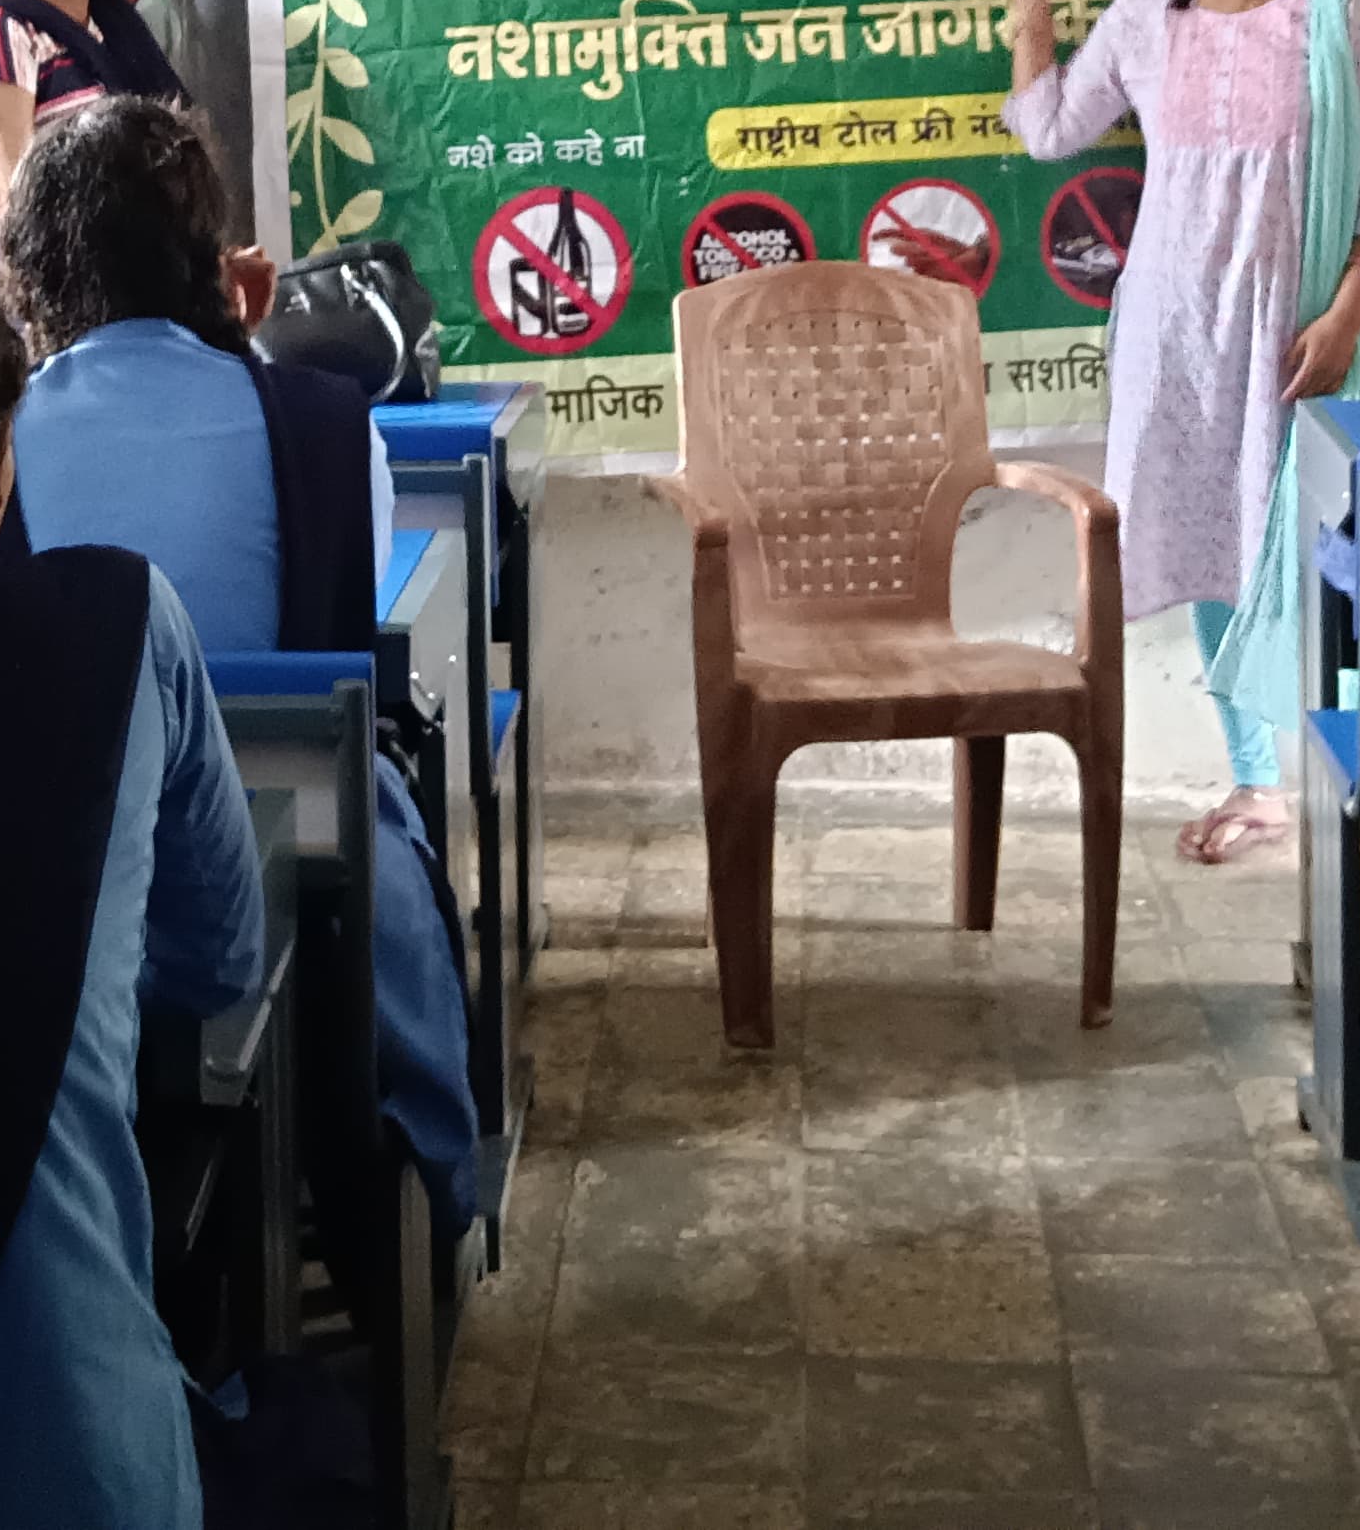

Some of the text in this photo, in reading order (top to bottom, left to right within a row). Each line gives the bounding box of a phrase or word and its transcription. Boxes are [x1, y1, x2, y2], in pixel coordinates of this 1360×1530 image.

[739, 5, 848, 64] जन
[447, 127, 646, 169] नशे को कहे ना
[736, 103, 1013, 157] राष्ट्रीय टोल फ्री नंब
[545, 374, 664, 423] माजिक
